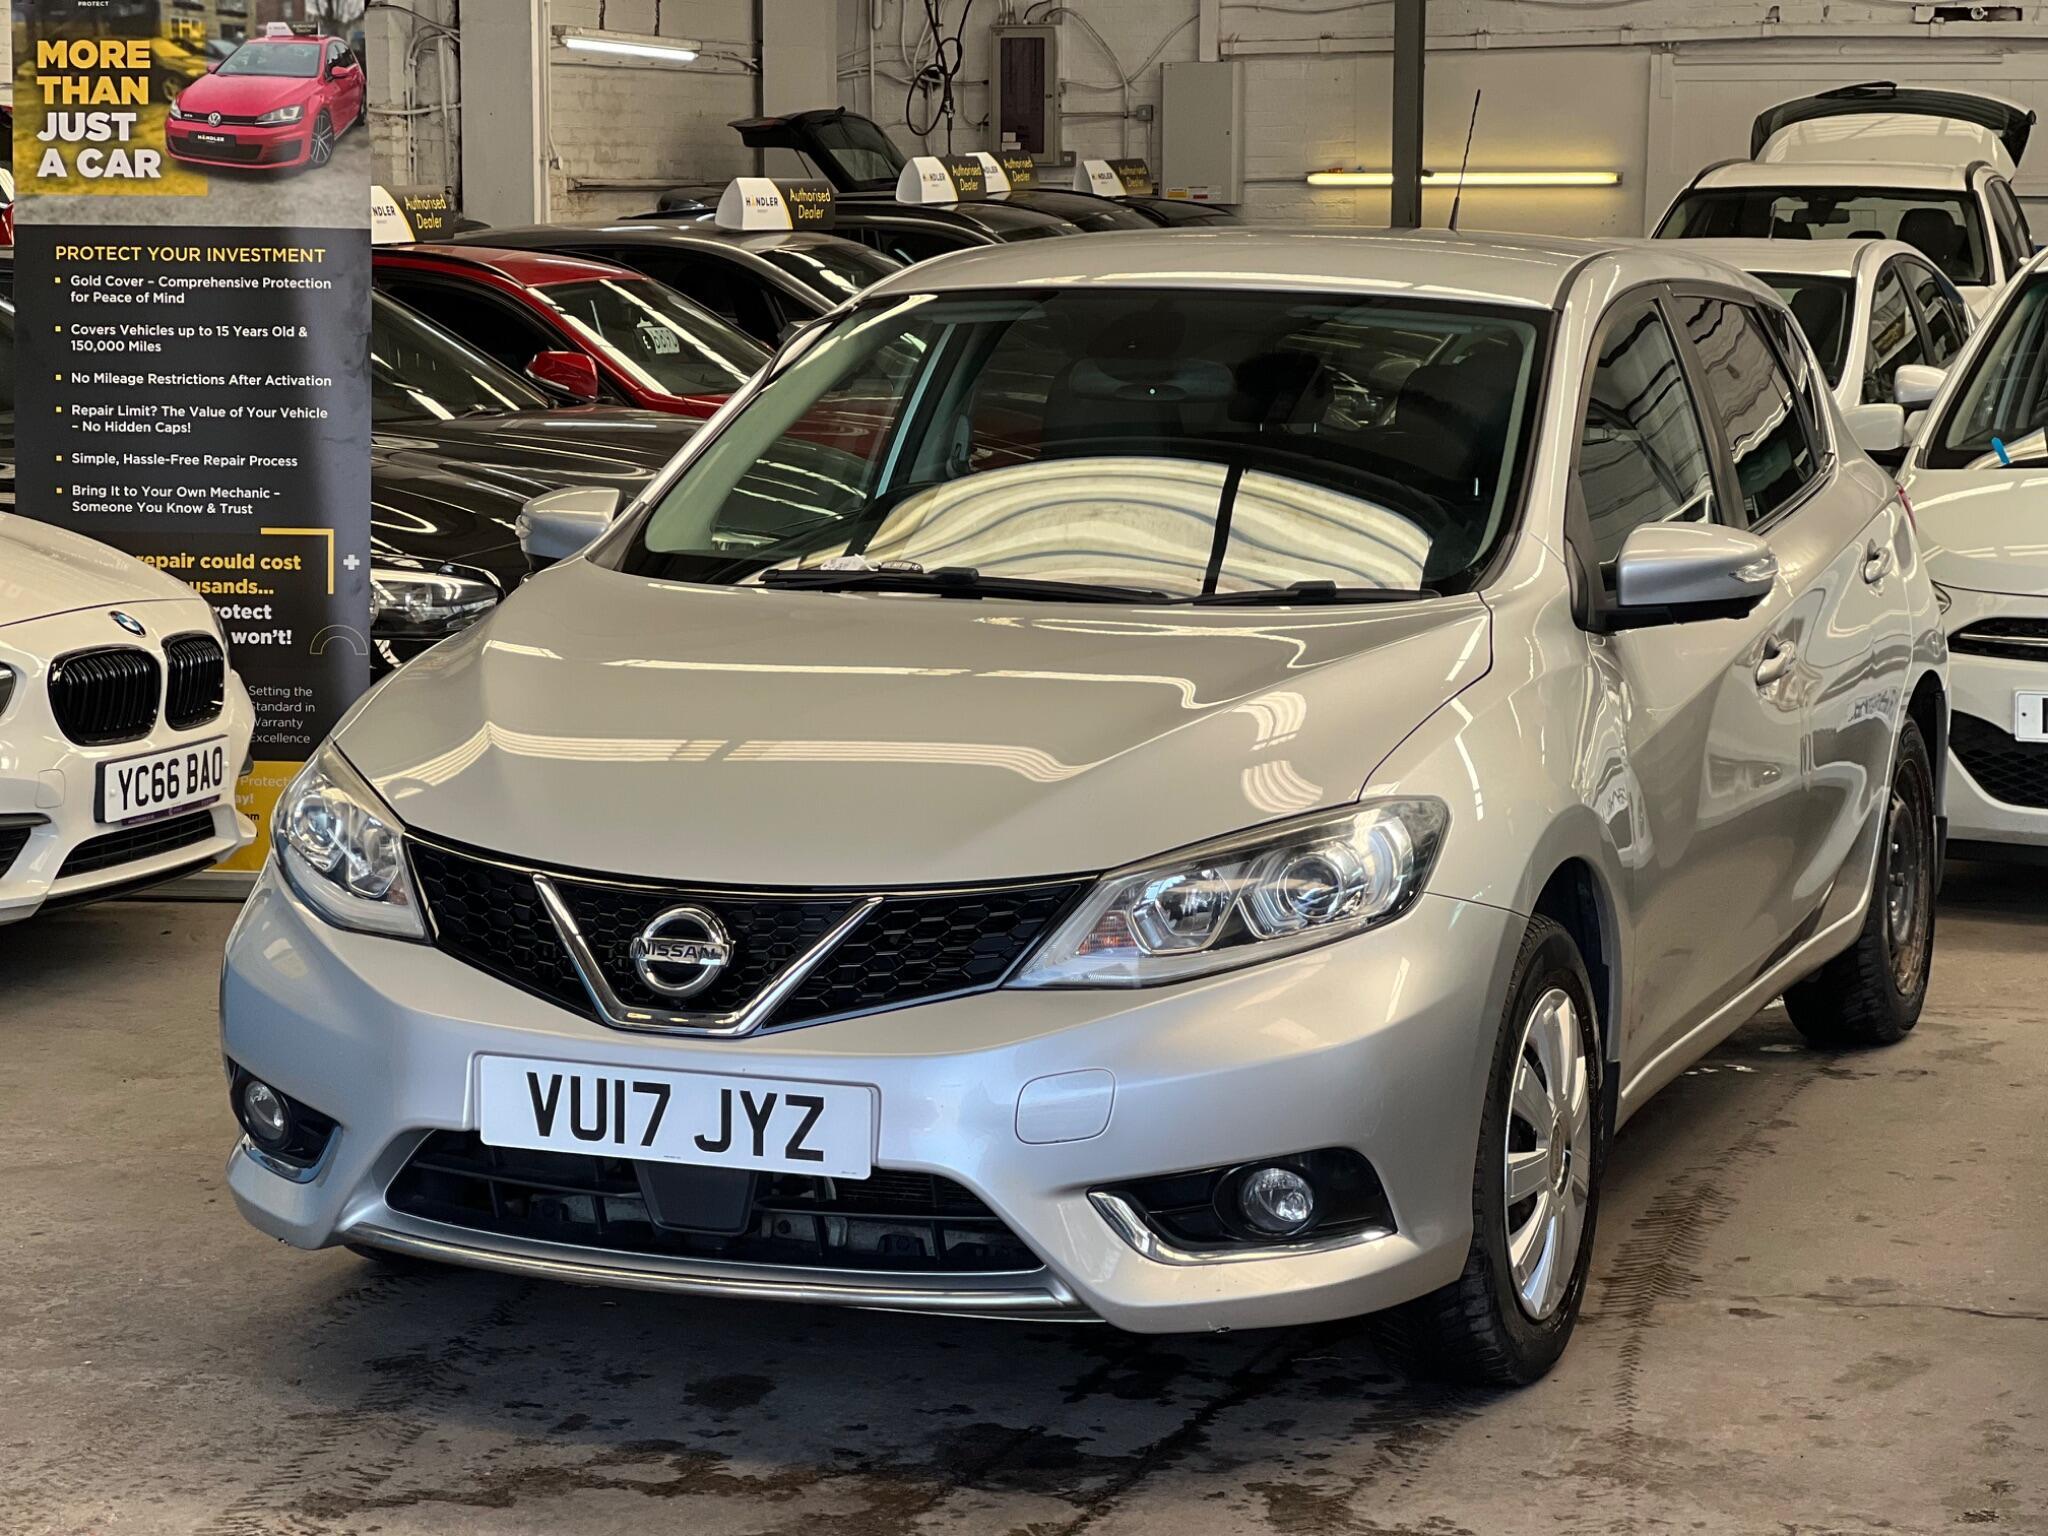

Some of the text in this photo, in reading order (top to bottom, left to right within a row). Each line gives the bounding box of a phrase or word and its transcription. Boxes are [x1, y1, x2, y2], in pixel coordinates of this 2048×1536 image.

[37, 40, 150, 69] MORE
[37, 76, 149, 105] THAN
[37, 112, 137, 142] JUST
[37, 148, 162, 179] A CAR
[952, 165, 982, 176] Authorised
[1004, 156, 1033, 170] Authorised
[1011, 170, 1031, 182] Dealer
[959, 178, 980, 191] Dealer
[404, 193, 447, 211] Authorised
[790, 186, 831, 202] Authorised
[798, 204, 825, 219] Dealer
[416, 212, 442, 230] Dealer
[56, 246, 326, 263] PROTECT YOUR INVESTMENT
[70, 274, 101, 287] Gold
[104, 275, 144, 288] Cover
[158, 276, 259, 290] Comprehensive
[262, 276, 332, 290] Protection
[70, 291, 185, 304] for Peace of Mind
[70, 324, 308, 340] Covers Vehicles up to 15 Years Old &
[70, 340, 162, 353] 150,000 Miles
[72, 372, 332, 387] No Mileage Restrictions After Activation
[72, 404, 328, 420] Repair Limit? The Value of Your Vehicle
[82, 422, 102, 433] No
[104, 422, 152, 434] Hidden
[154, 422, 192, 436] Caps!
[72, 452, 298, 470] Simple, Hassle-Free Repair Process
[72, 485, 108, 500] Bring
[111, 486, 120, 498] It
[124, 486, 138, 498] to
[142, 486, 173, 498] Your
[176, 486, 207, 498] Own
[210, 486, 270, 500] Mechanic
[72, 502, 253, 516] Someone You Know & Trust
[200, 552, 255, 569] could
[260, 555, 302, 570] cost
[248, 686, 313, 698] Setting the
[305, 702, 316, 713] in
[118, 758, 180, 810] YC66
[187, 746, 222, 795] BAO
[638, 940, 722, 962] NISSAN
[526, 1072, 825, 1162] VU17 JYZ
